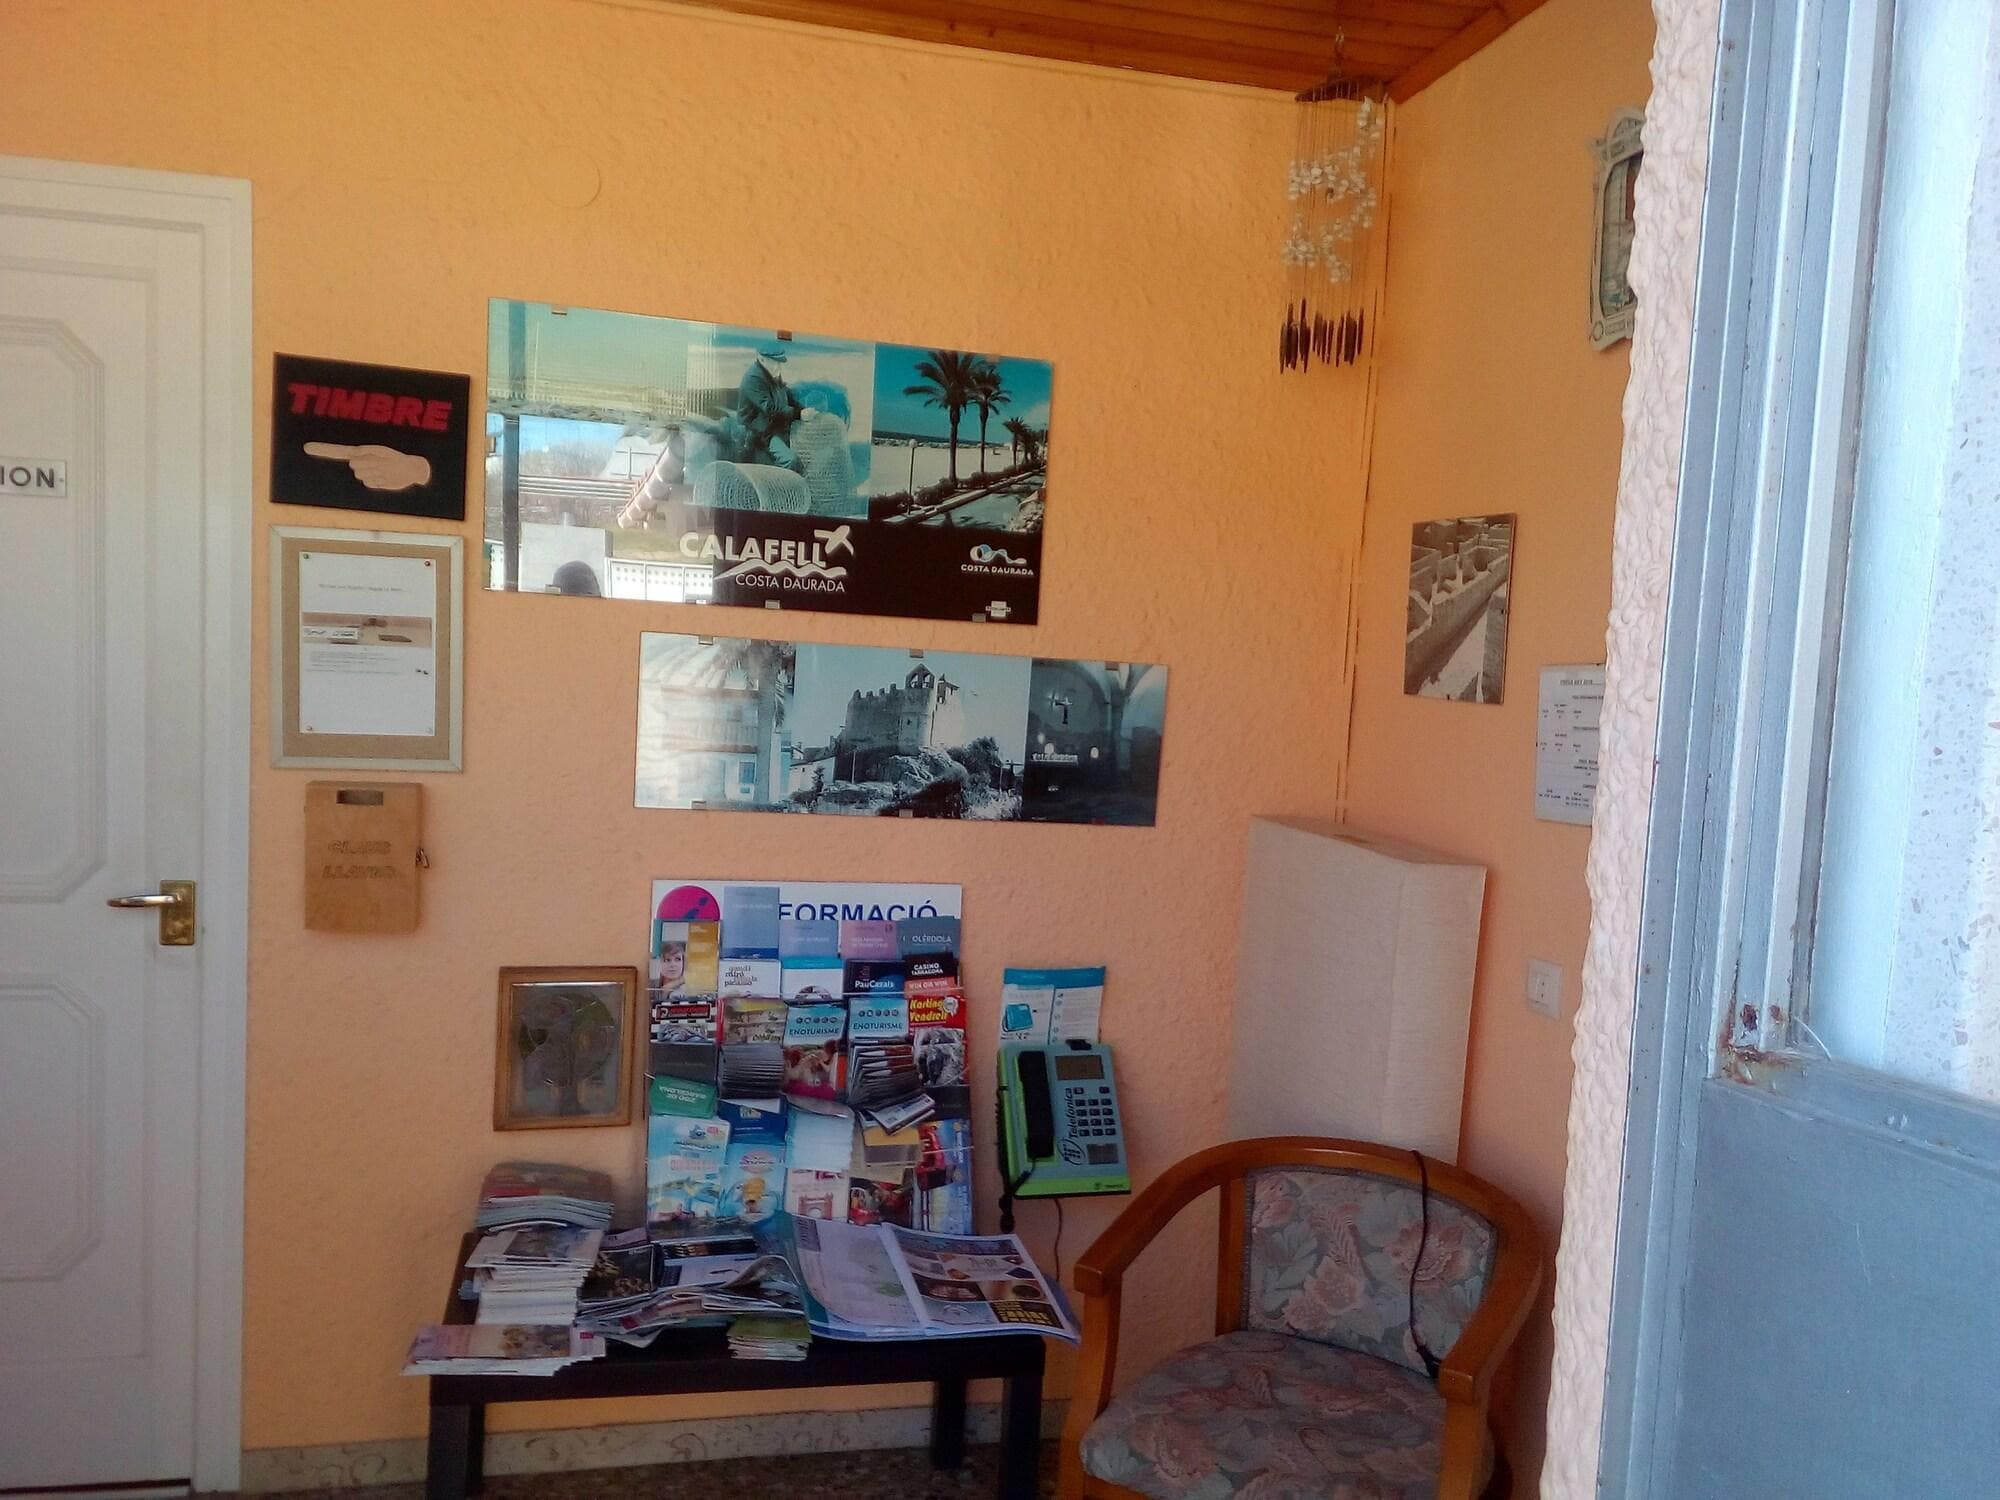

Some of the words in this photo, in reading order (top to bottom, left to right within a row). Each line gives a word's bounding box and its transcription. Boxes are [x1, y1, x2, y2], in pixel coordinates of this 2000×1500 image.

[287, 382, 453, 432] TIMBRE
[679, 532, 827, 568] CALAFELL
[960, 564, 990, 573] COSTA
[991, 566, 1034, 576] DAURADA
[735, 573, 780, 588] COSTA
[783, 577, 846, 593] DAURADA
[778, 899, 937, 920] FORMACIÓ
[913, 962, 940, 971] CASINO
[788, 1027, 840, 1036] ENOTURISME
[853, 1022, 903, 1031] ENOTURISME
